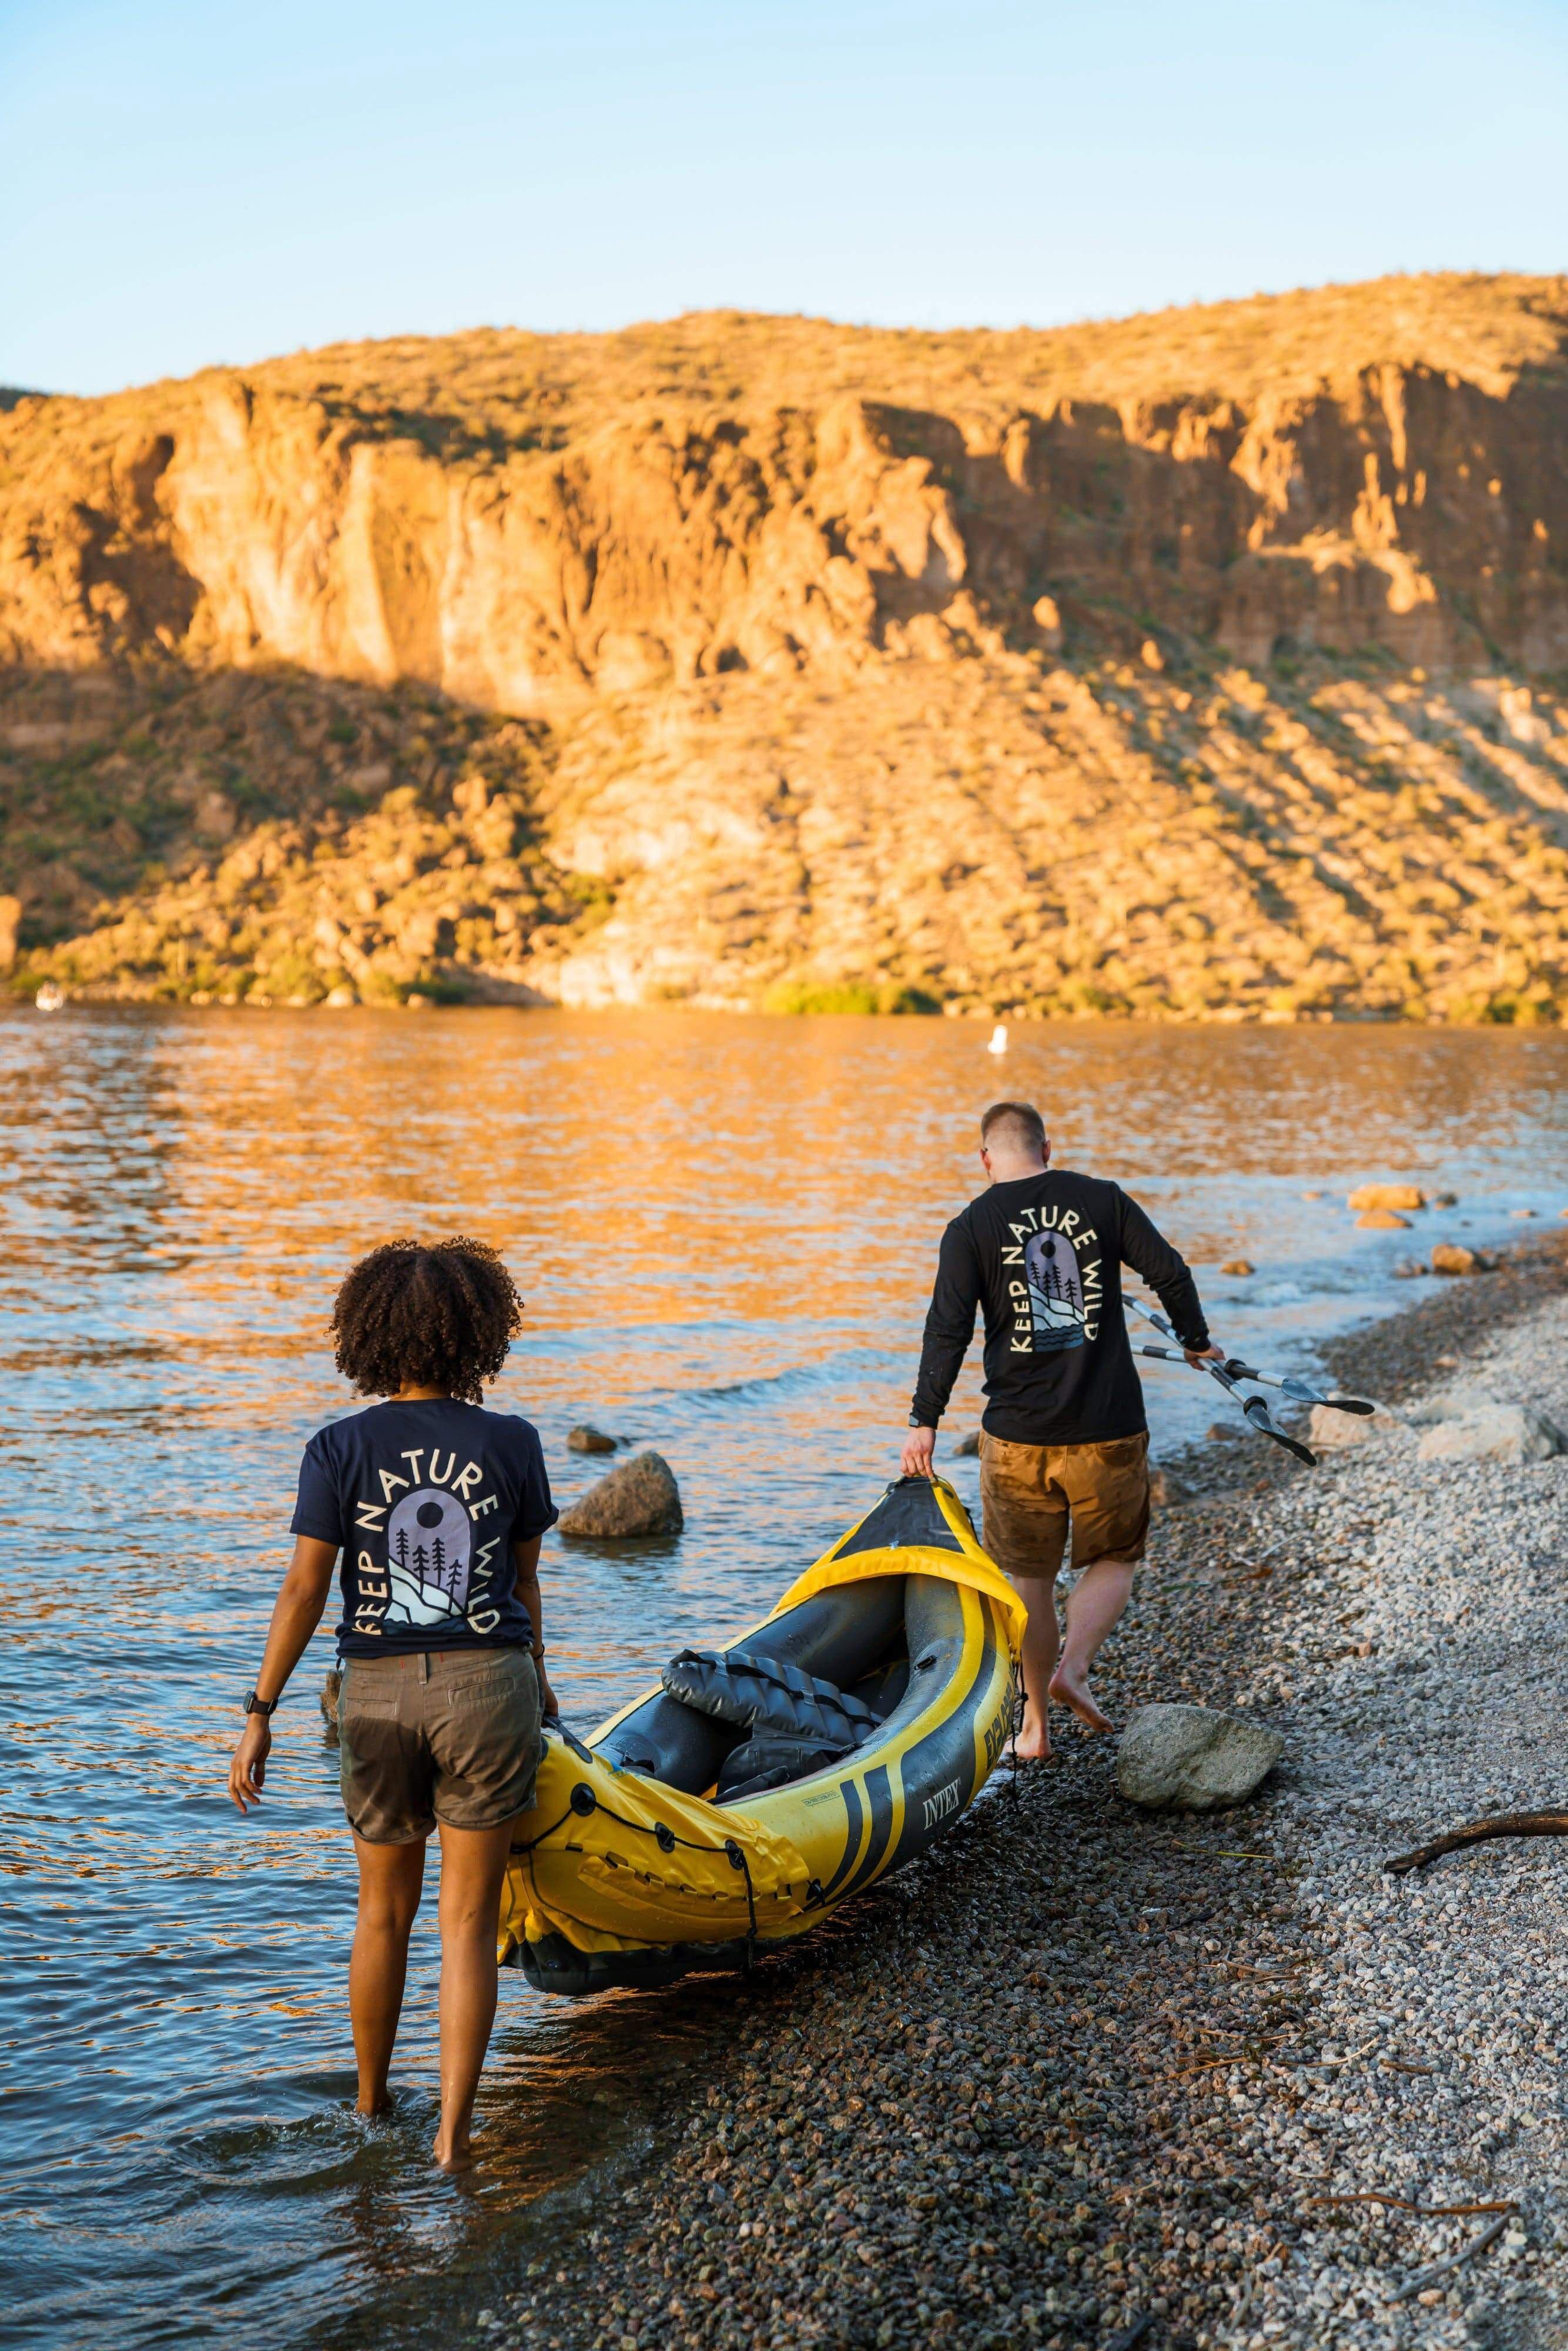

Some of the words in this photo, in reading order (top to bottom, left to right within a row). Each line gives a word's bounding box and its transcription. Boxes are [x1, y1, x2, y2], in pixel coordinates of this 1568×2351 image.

[1001, 1205, 1098, 1265] NATURE
[1009, 1280, 1033, 1352] KEEP
[1082, 1258, 1103, 1341] WILD
[354, 1448, 499, 1532] NATURE
[351, 1550, 388, 1636] KEEP
[467, 1536, 500, 1635] WILD
[922, 1778, 960, 1830] INTEX
